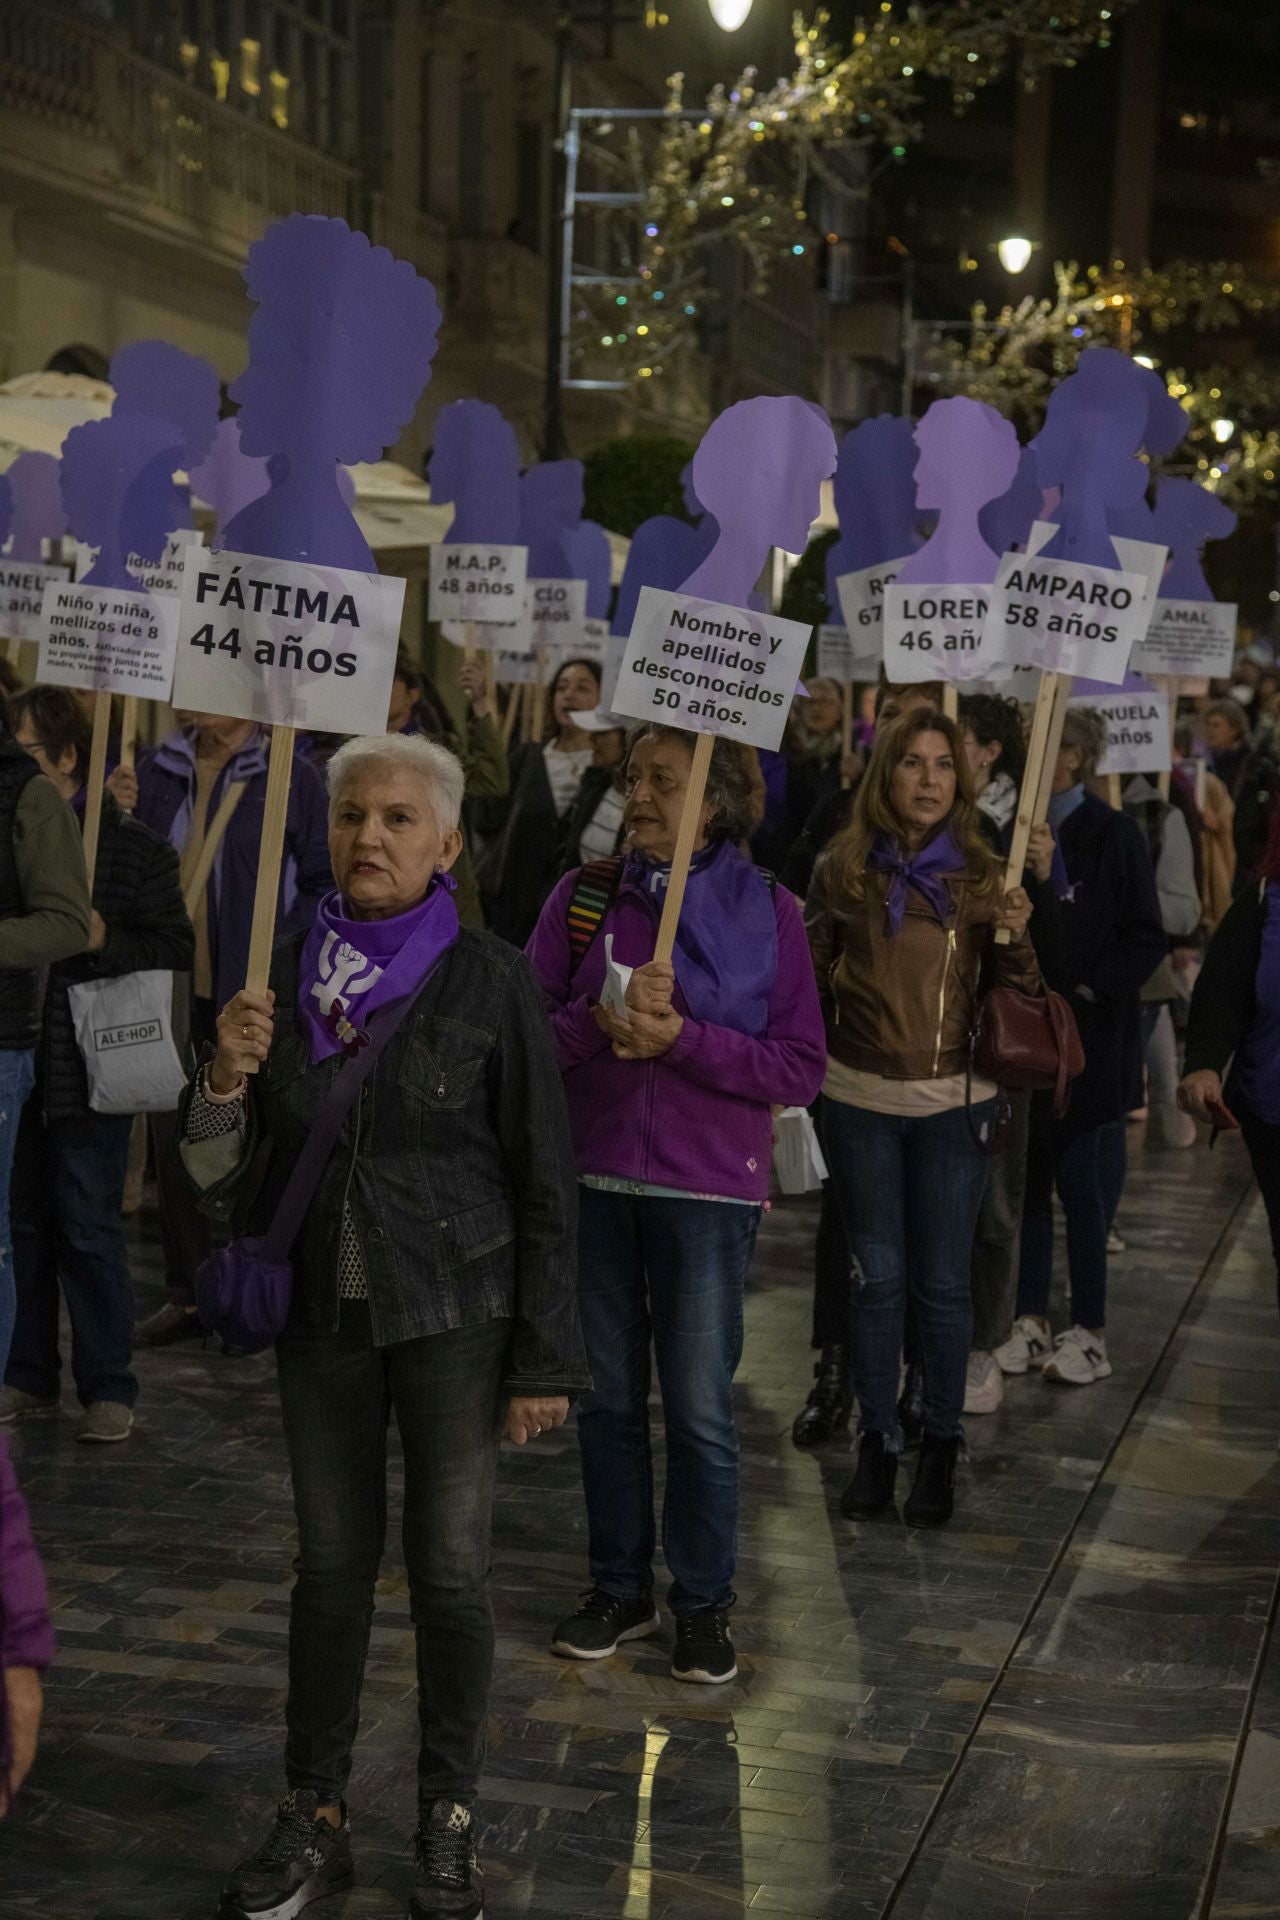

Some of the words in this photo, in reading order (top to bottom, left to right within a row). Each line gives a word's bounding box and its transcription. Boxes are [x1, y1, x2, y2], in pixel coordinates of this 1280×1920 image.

[446, 555, 507, 572] M.A.P.
[196, 566, 361, 628] FÁTIMA
[438, 578, 461, 594] 48
[465, 577, 514, 595] años
[1004, 569, 1132, 611] AMPARO
[57, 594, 93, 612] Niño
[99, 601, 107, 616] y
[113, 602, 155, 622] niña,
[533, 606, 570, 622] años
[858, 605, 882, 626] 67
[1162, 609, 1210, 624] AMAL
[50, 614, 115, 633] mellizos
[121, 622, 142, 637] de
[148, 626, 158, 640] 8
[669, 609, 761, 647] Nombre
[768, 635, 783, 655] y
[1004, 603, 1039, 628] 58
[1047, 612, 1119, 643] años
[49, 633, 89, 648] años.
[144, 647, 160, 660] por
[190, 623, 241, 659] 44
[254, 635, 358, 677] años
[900, 631, 933, 651] 46
[48, 649, 58, 657] su
[59, 649, 86, 662] propio
[88, 651, 112, 664] padre
[115, 655, 140, 668] junto
[151, 664, 162, 672] su
[662, 638, 766, 675] apellidos
[47, 658, 74, 671] madre,
[113, 665, 125, 675] de
[127, 669, 139, 678] 43
[141, 669, 166, 682] años.
[632, 656, 785, 708] desconocidos
[651, 688, 681, 709] 50
[687, 699, 748, 726] años.
[1108, 727, 1153, 745] años
